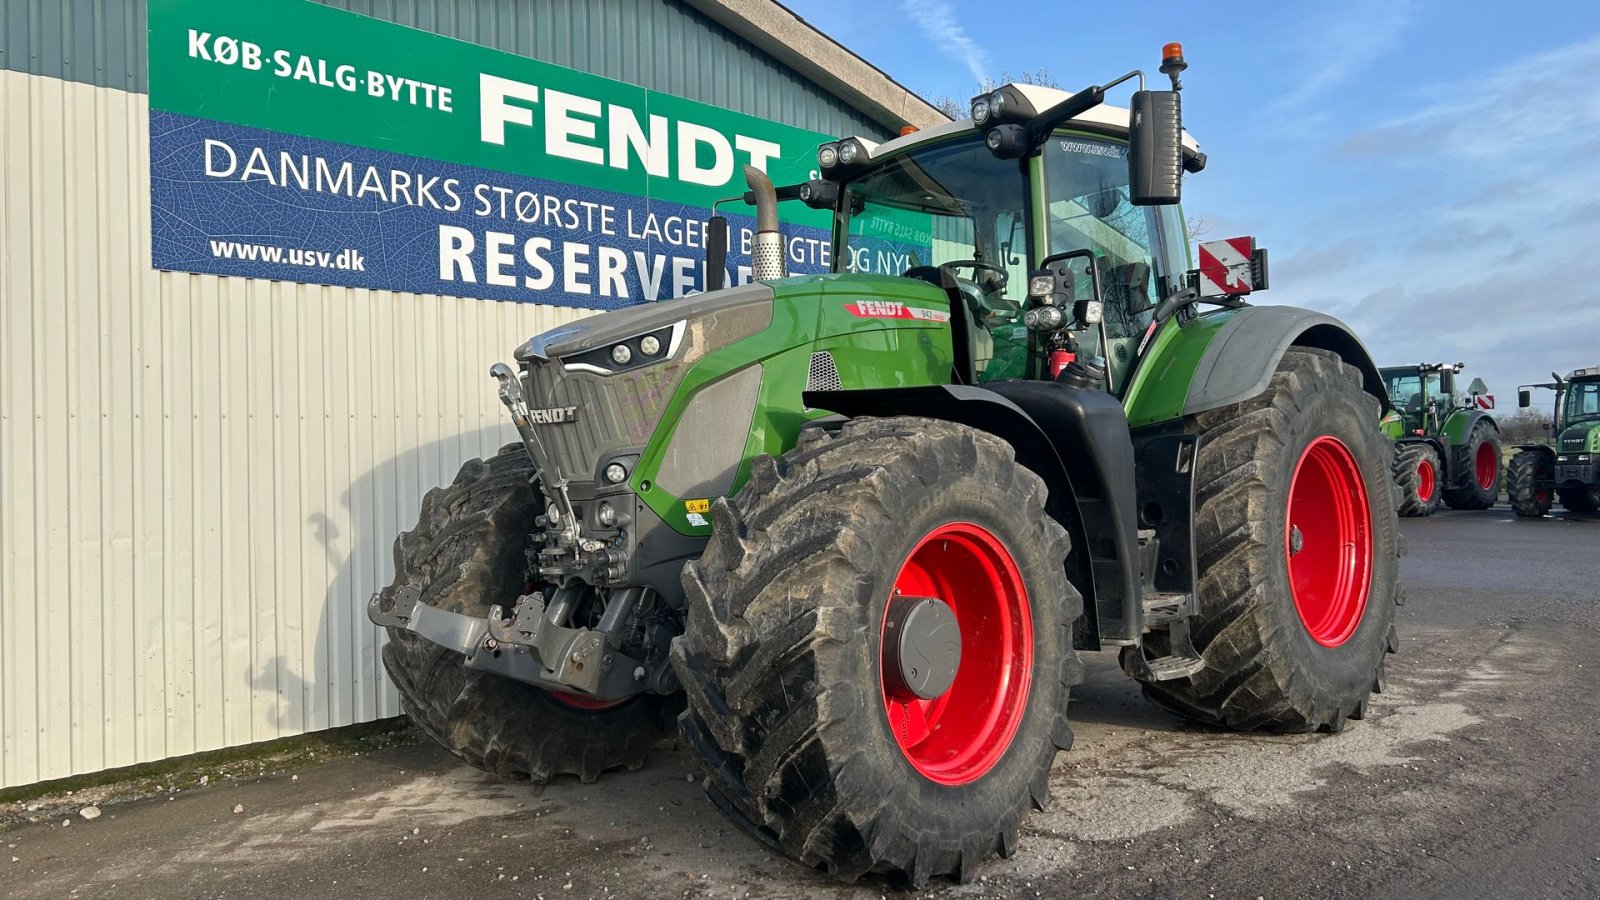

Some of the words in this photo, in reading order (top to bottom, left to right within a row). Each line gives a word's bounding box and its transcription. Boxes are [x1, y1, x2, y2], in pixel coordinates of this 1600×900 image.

[479, 73, 780, 187] FENDT
[204, 139, 461, 212] DANMARKS
[474, 184, 615, 235] STØRSTE
[741, 228, 831, 267] BGTE
[209, 240, 365, 271] www.usv.dk
[856, 300, 904, 316] FENDT
[530, 406, 577, 424] FENDT
